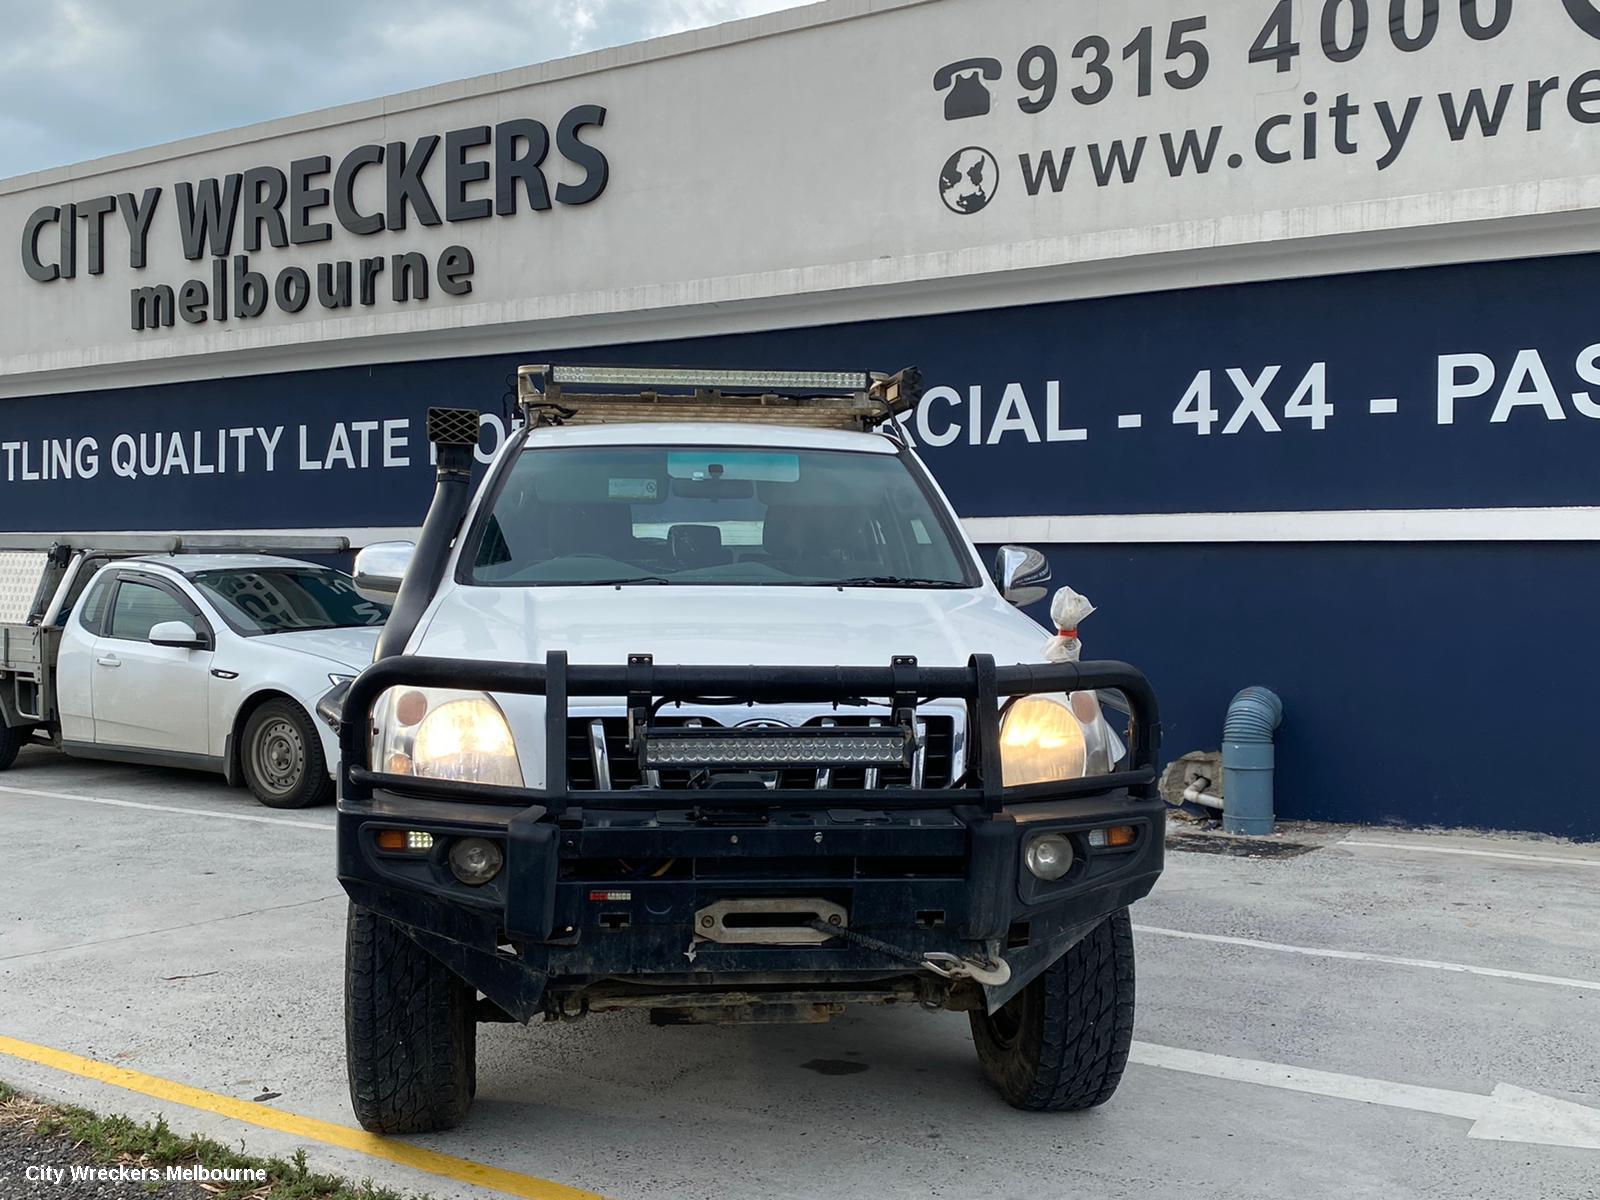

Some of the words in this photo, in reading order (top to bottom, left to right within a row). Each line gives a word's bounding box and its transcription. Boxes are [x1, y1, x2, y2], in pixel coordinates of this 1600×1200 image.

[1017, 15, 1209, 114] 9315
[21, 187, 162, 282] CITY
[174, 104, 609, 261] WRECKERS
[130, 245, 474, 330] melbourne
[2, 437, 98, 481] TLING
[111, 426, 284, 479] QUALITY
[299, 419, 410, 469] LATE
[1118, 414, 1141, 428] -
[1173, 362, 1333, 435] 4X4
[1369, 399, 1397, 413] -
